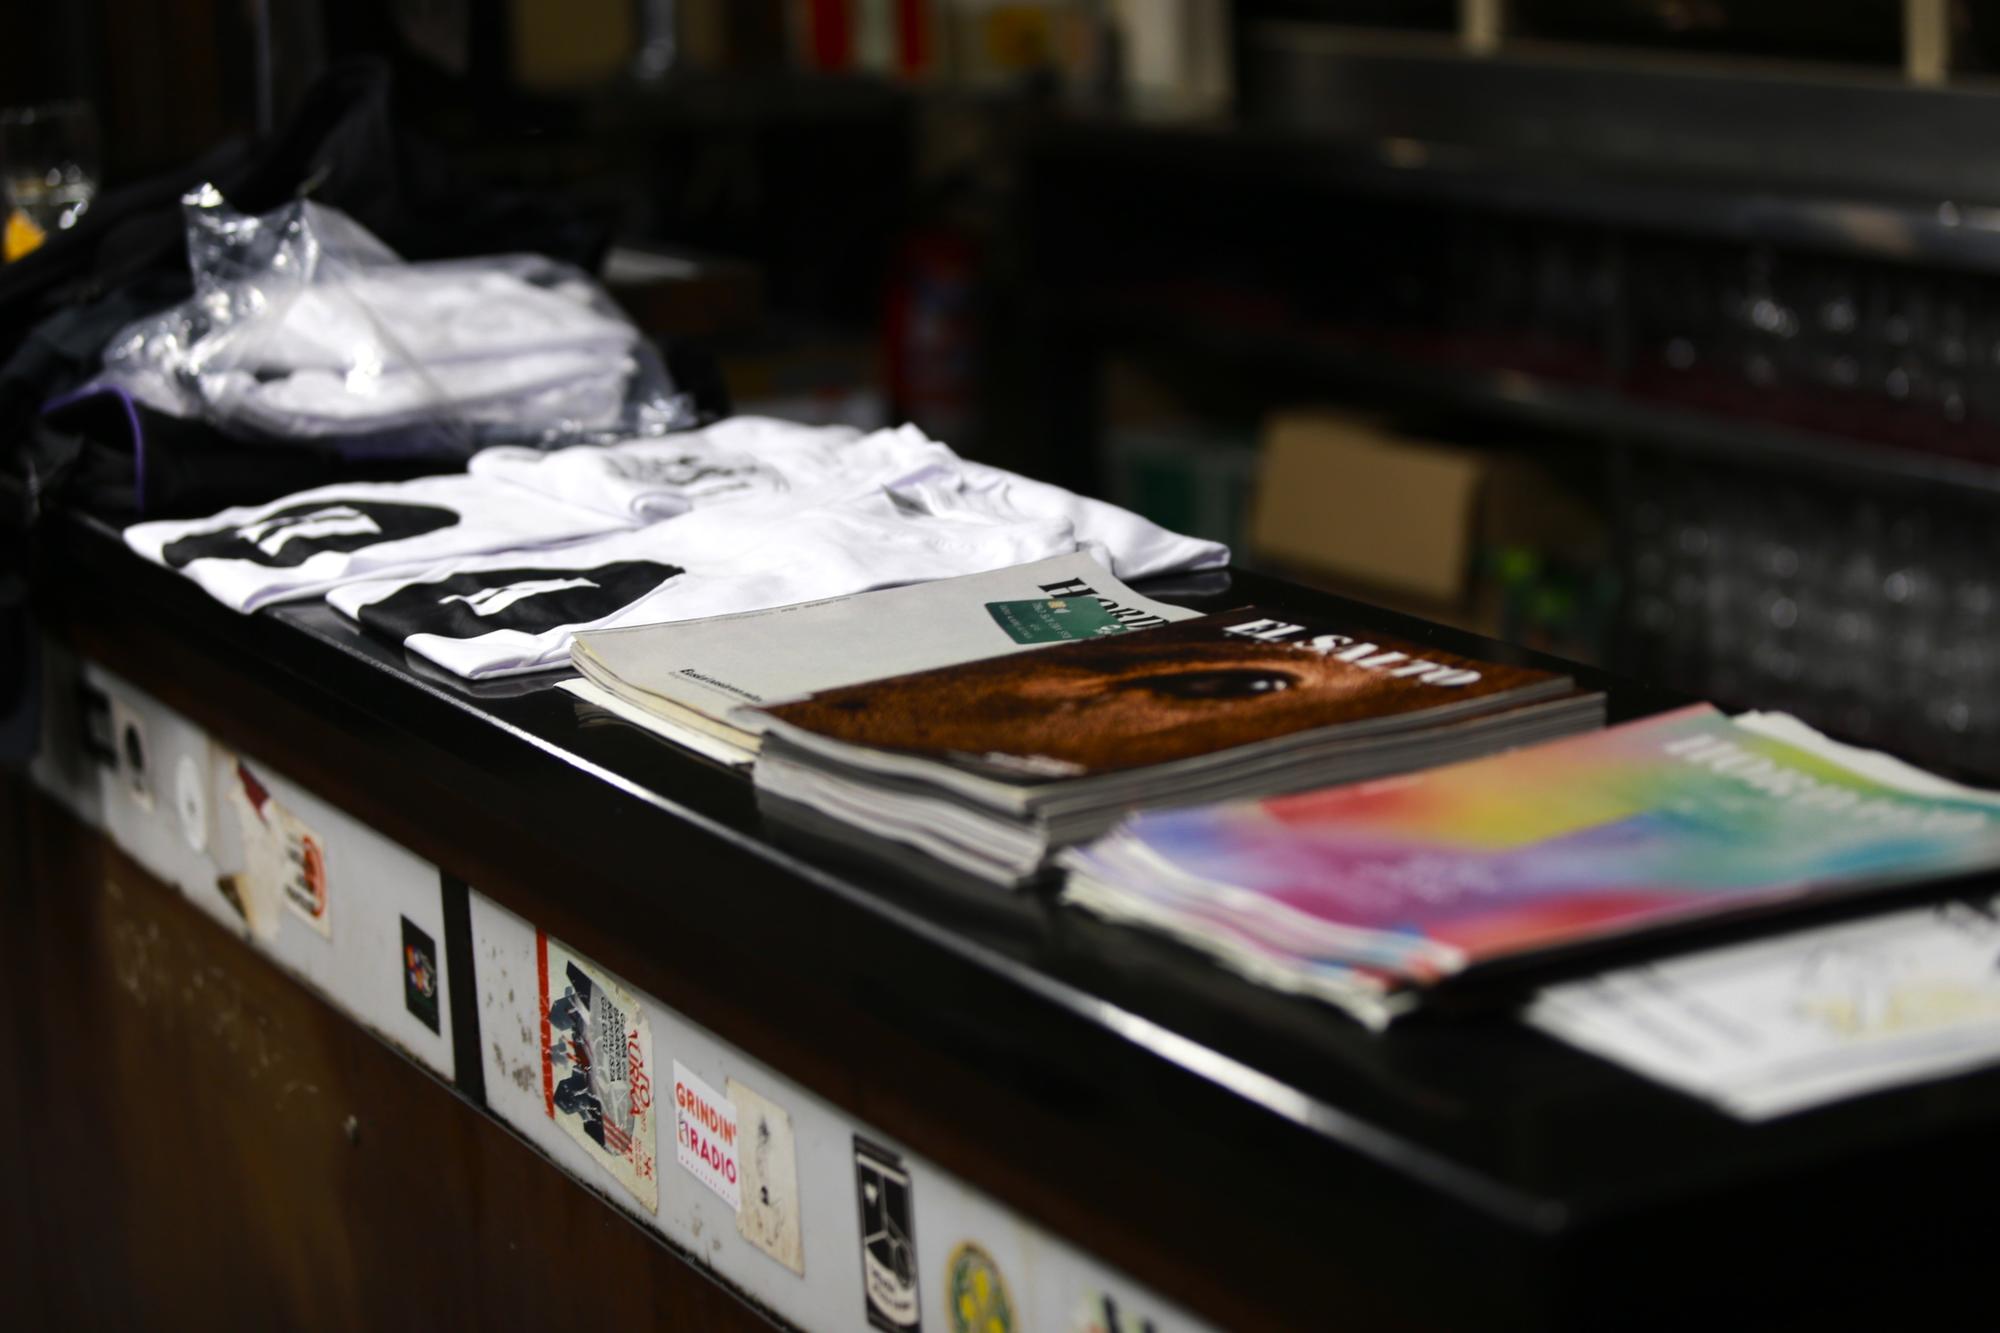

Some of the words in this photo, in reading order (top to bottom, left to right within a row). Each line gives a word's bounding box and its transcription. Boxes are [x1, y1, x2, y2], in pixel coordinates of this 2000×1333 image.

[1222, 618, 1308, 643] EL
[1288, 634, 1482, 687] SALTO
[675, 1081, 737, 1147] GRINDIN'
[690, 1127, 737, 1184] RADIO
